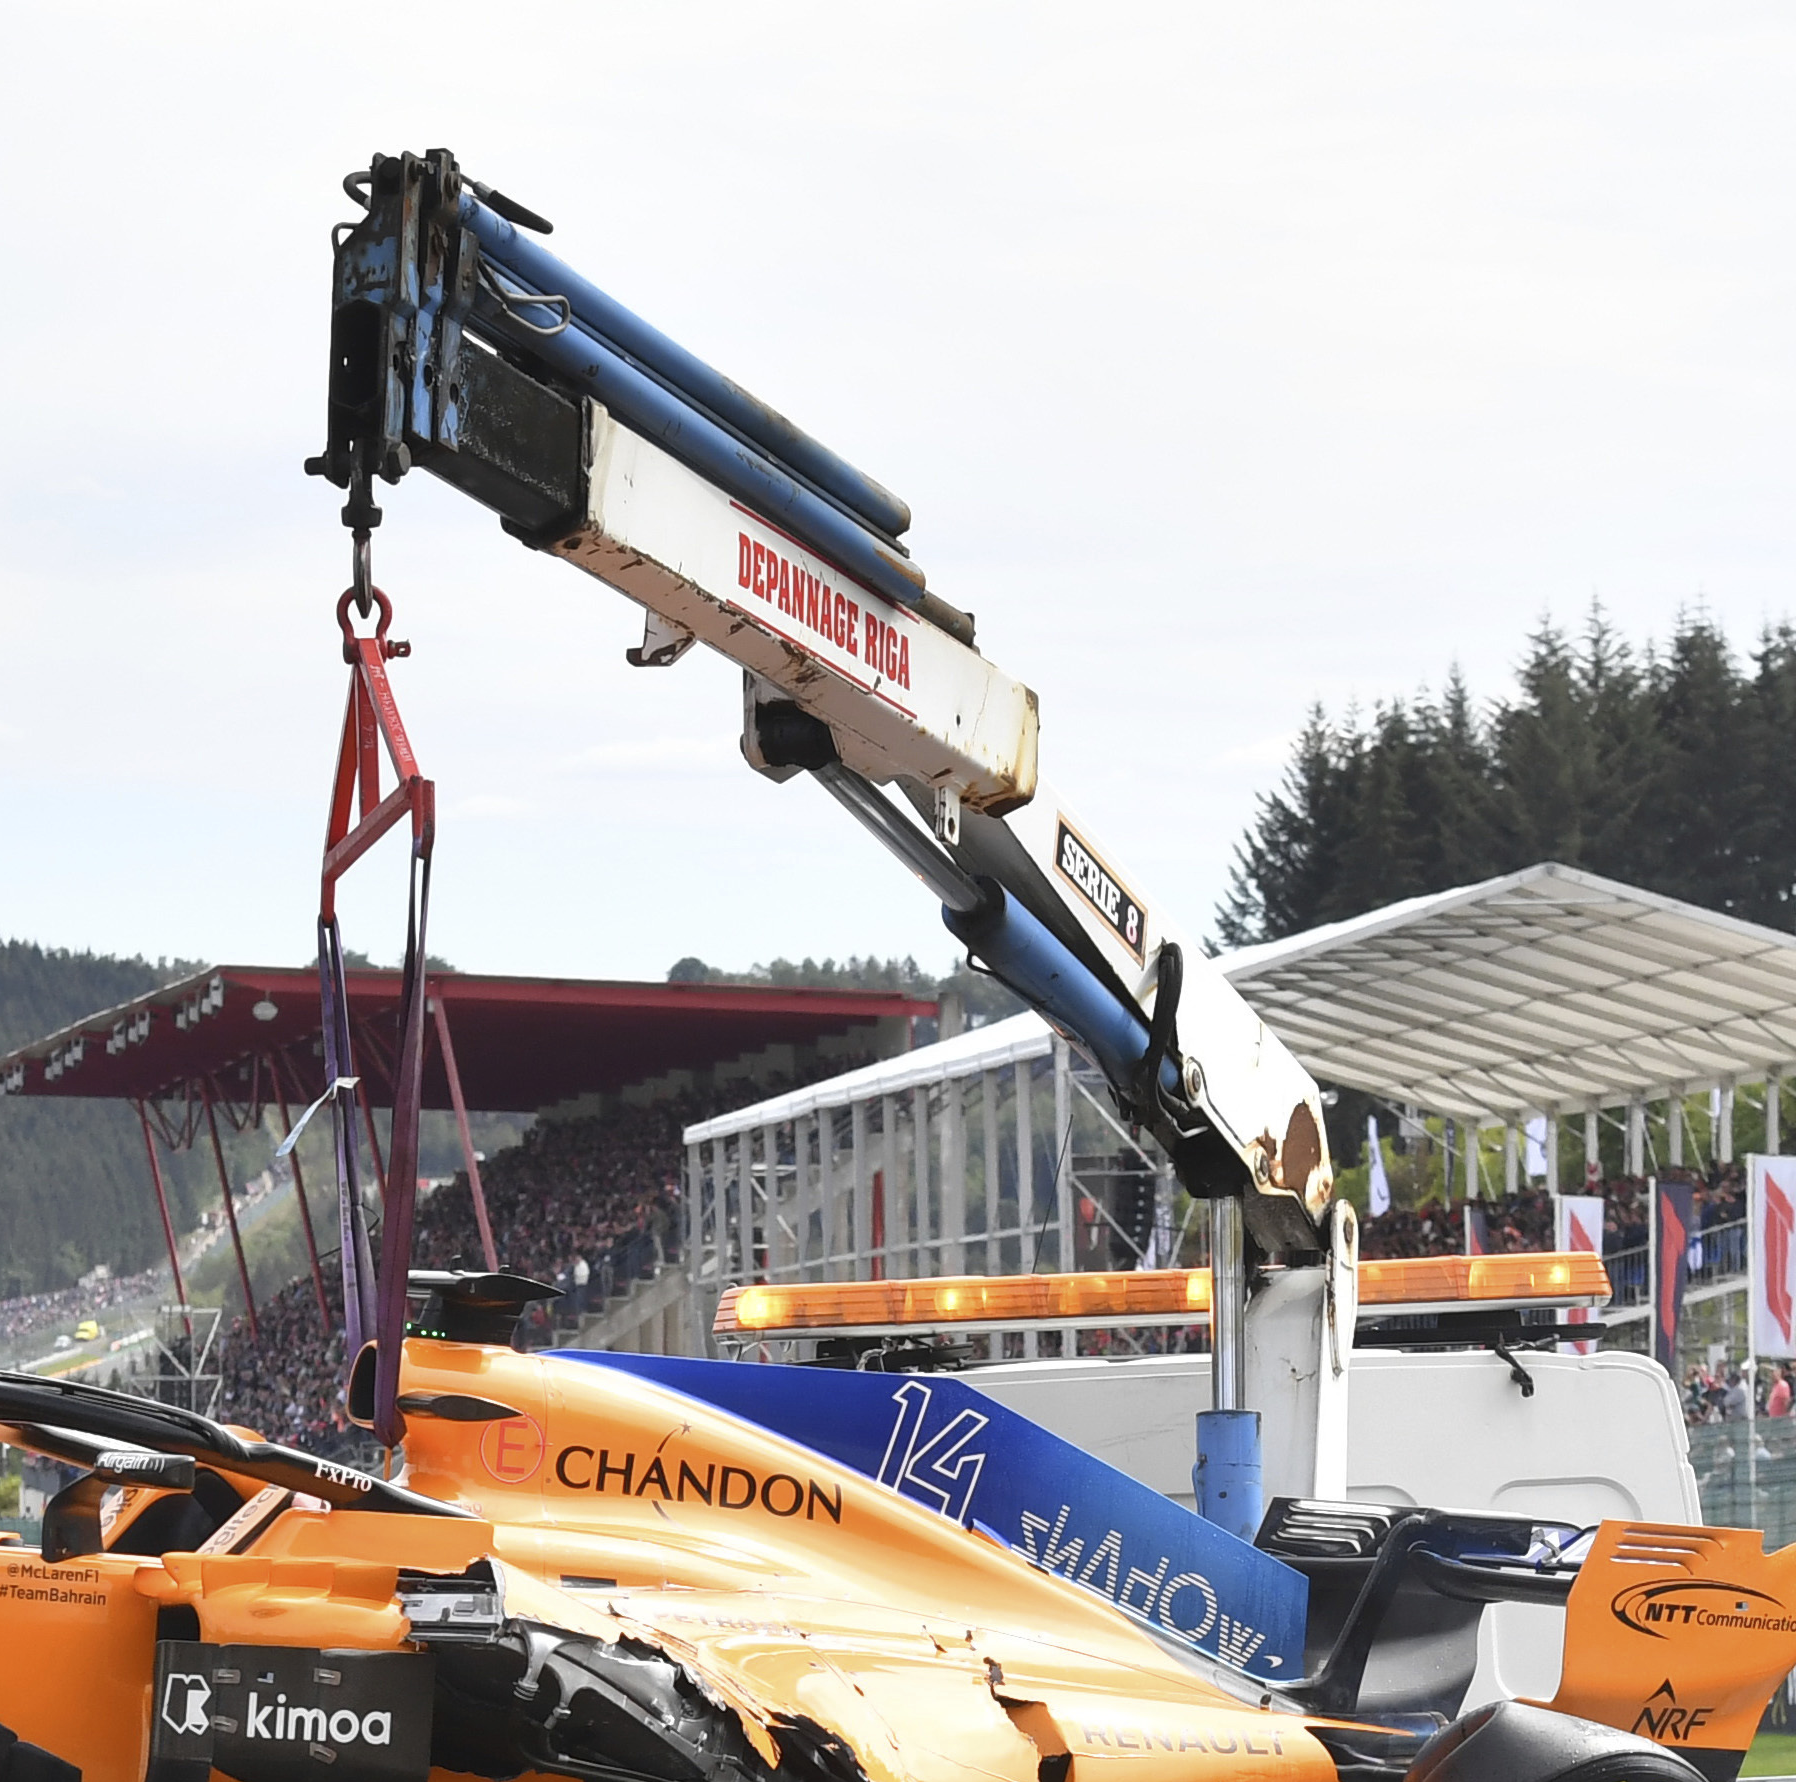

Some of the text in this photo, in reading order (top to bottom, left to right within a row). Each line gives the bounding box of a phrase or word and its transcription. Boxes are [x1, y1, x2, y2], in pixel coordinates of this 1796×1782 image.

[737, 531, 911, 692] DEPANNAGE RIGA
[1060, 831, 1140, 945] SERIE 8
[877, 1379, 990, 1527] 14
[314, 1461, 373, 1493] FxPro
[555, 1443, 845, 1526] CHANDON
[5, 1562, 100, 1585] @McLarenF1
[1644, 1602, 1698, 1624] NTT
[245, 1691, 392, 1746] kimoa
[1079, 1722, 1287, 1758] RENAULT
[1630, 1706, 1716, 1742] NRF
